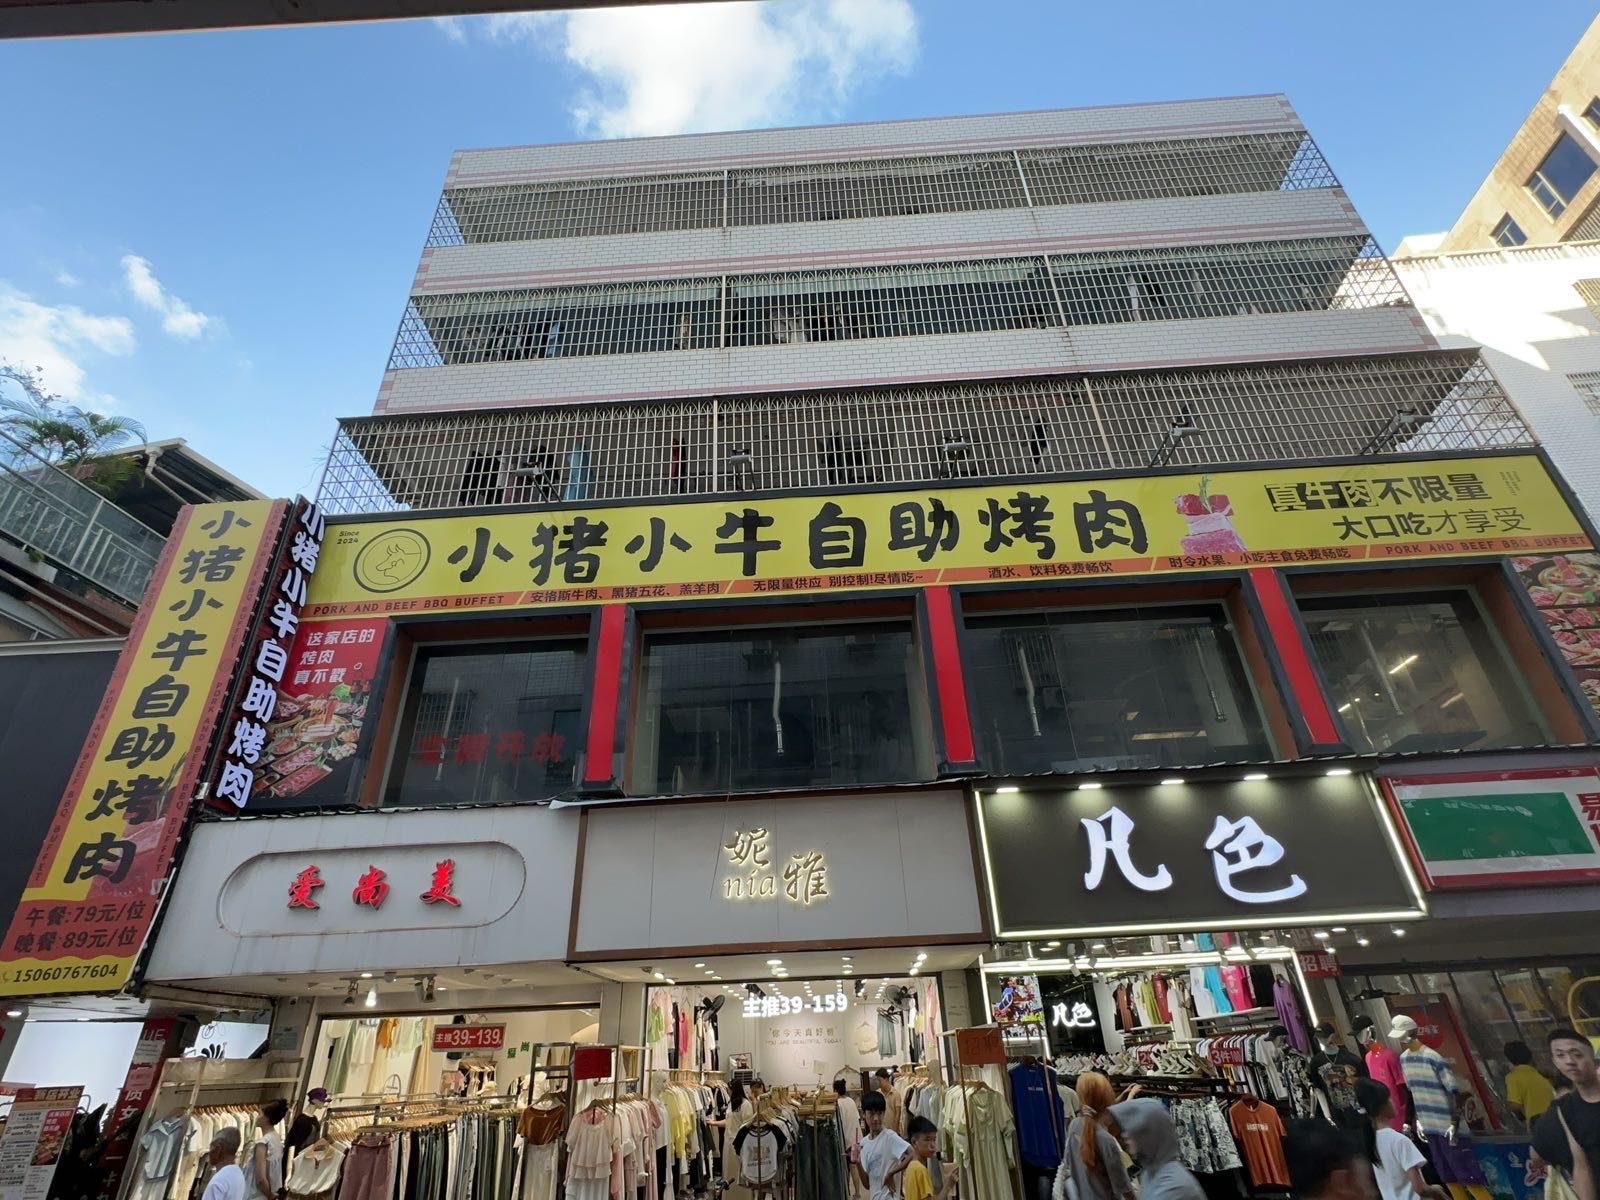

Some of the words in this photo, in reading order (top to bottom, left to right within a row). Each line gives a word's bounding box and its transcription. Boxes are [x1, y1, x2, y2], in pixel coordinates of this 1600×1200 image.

[1264, 473, 1492, 512] 真牛肉不限量
[1333, 507, 1531, 540] 大口吃才享受
[447, 490, 1148, 586] 小猪小牛自助烤肉
[1385, 544, 1424, 555] PORK
[1429, 543, 1455, 552] AND
[1460, 540, 1495, 551] BEEF
[1502, 539, 1529, 549] BBQ
[1535, 536, 1586, 547] BUFFET
[753, 577, 822, 592] 无限量供应
[313, 605, 347, 615] PORK
[354, 602, 379, 612] AND
[385, 600, 418, 611] BEEF
[424, 599, 449, 609] BBQ
[455, 596, 505, 607] BUFFET
[306, 628, 376, 646] 这家店的
[215, 505, 326, 808] 小猪小牛自助烤肉
[299, 649, 335, 665] 烤肉
[63, 509, 252, 884] 小猪小牛自助烤肉
[207, 683, 222, 712] PORK
[198, 718, 211, 741] AND
[186, 745, 201, 777] BEEF
[61, 790, 74, 818] BBQ
[176, 783, 189, 810] BBQ
[156, 817, 176, 872] BUFFET
[724, 828, 770, 866] 妮
[1080, 806, 1307, 903] 凡色
[784, 851, 828, 904] 雅
[26, 901, 146, 927] 午餐:79元/位
[13, 964, 119, 982] 15060767604
[1299, 953, 1338, 972] 招聘
[742, 993, 848, 1018] 主推39-159
[1052, 1001, 1096, 1027] 凡色
